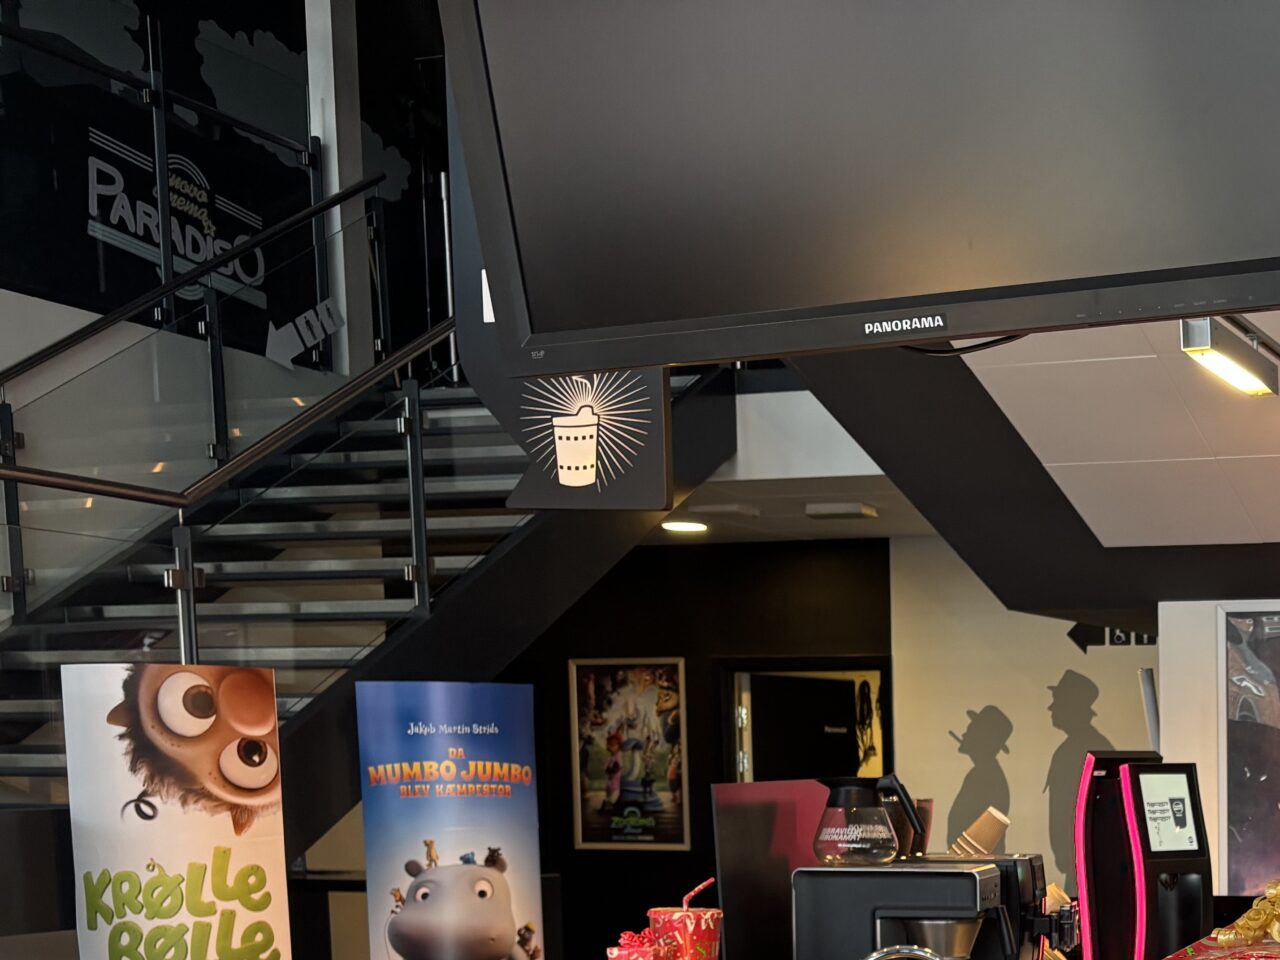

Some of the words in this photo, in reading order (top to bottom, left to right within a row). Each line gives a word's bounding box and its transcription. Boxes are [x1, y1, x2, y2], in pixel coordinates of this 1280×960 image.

[864, 315, 944, 334] PANORAMA
[439, 724, 471, 735] Martin
[448, 747, 465, 759] DA
[368, 760, 457, 786] MUMBO
[461, 760, 533, 785] JUMBO
[400, 784, 430, 798] BLEV
